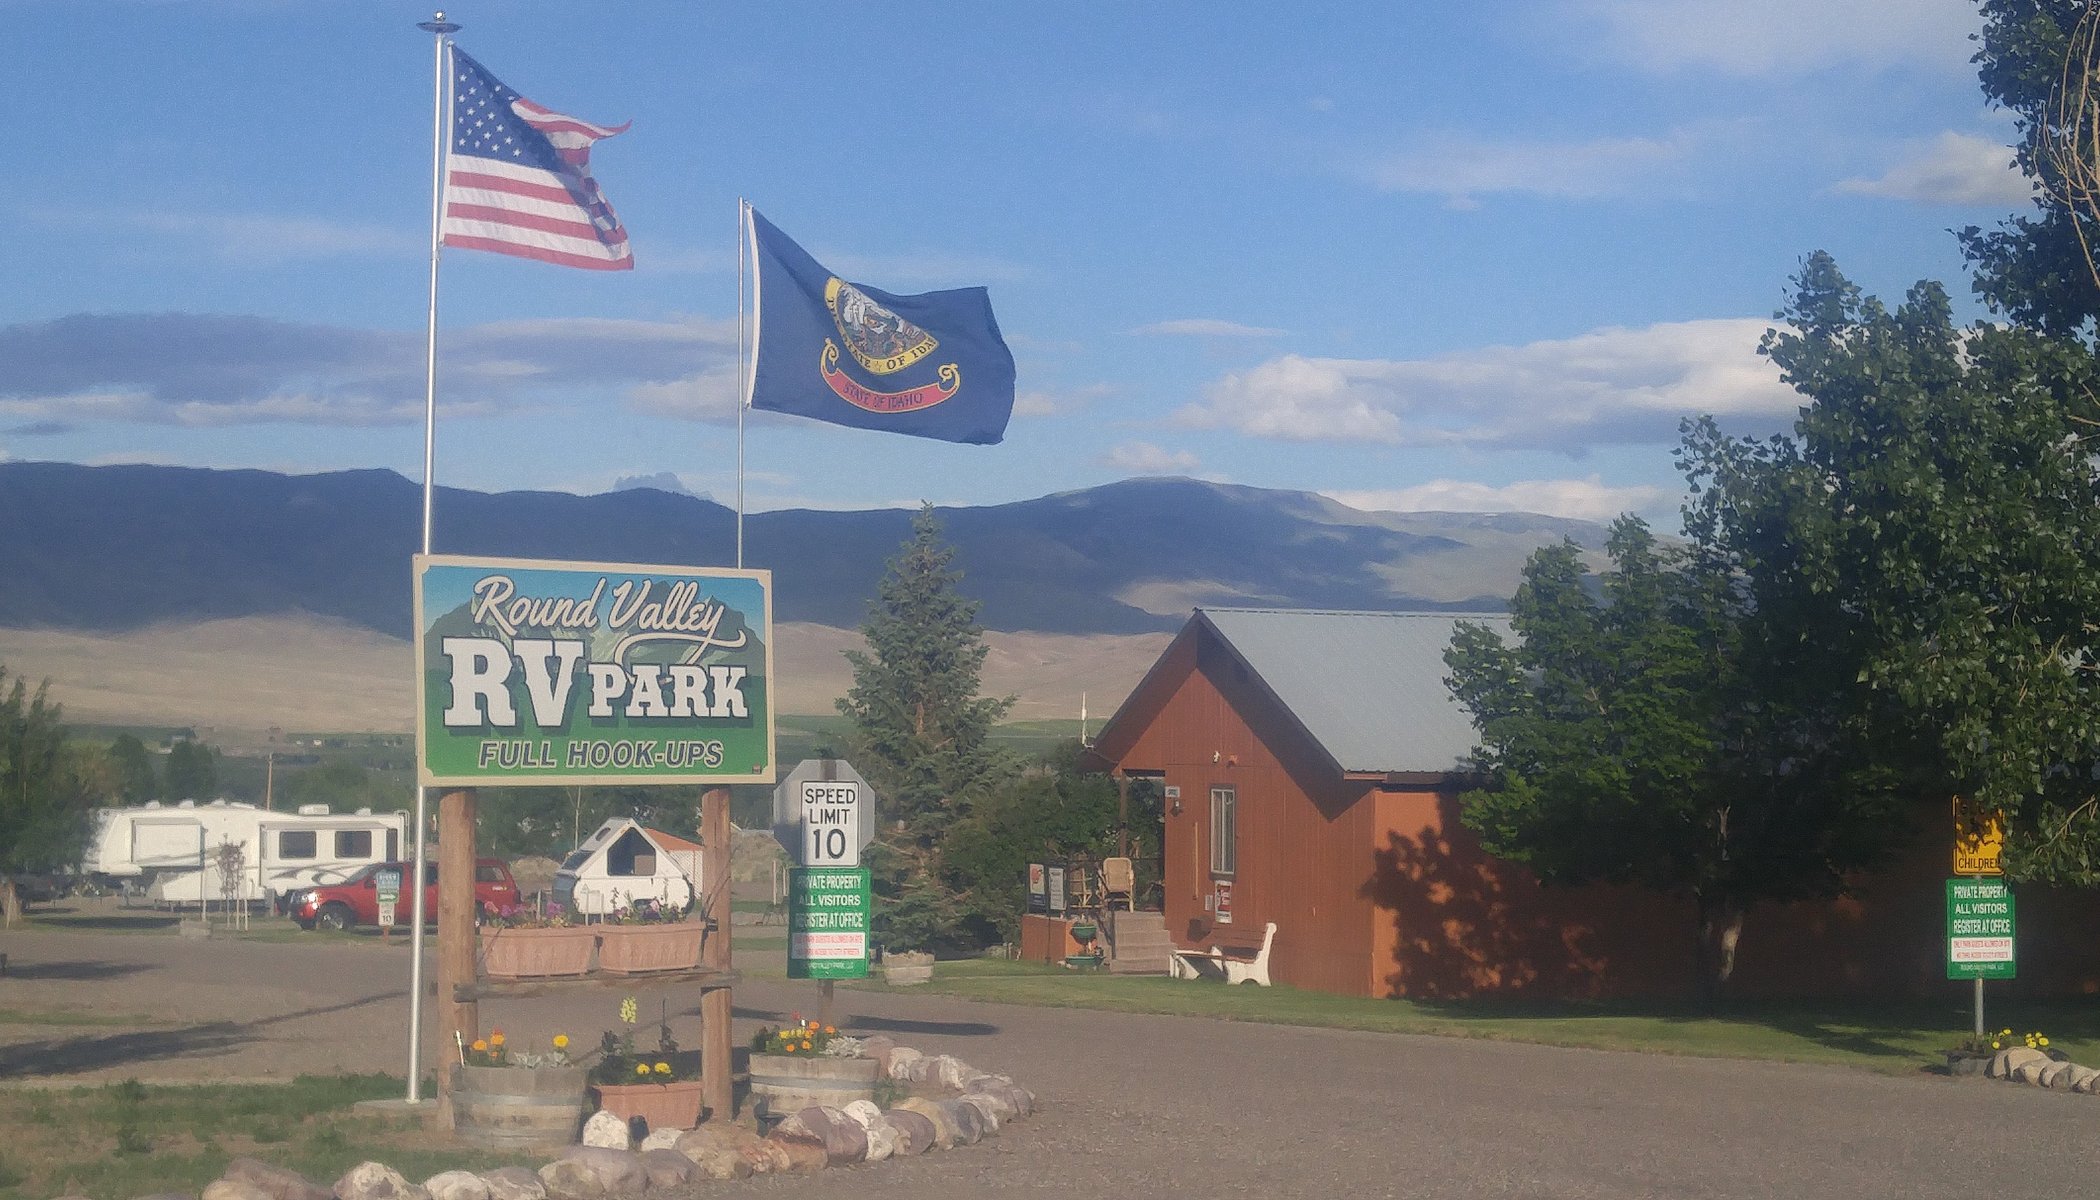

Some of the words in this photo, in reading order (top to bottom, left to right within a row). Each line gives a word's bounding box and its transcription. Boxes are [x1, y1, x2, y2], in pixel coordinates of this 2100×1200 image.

[886, 356, 906, 370] OF
[888, 393, 923, 409] IDAHO
[474, 575, 607, 636] Round
[608, 578, 744, 656] Valley
[442, 637, 585, 728] RV
[588, 663, 748, 718] PARK
[478, 740, 557, 769] FULL
[566, 740, 724, 769] HOOK-UPS
[804, 788, 856, 804] SPEED
[809, 808, 851, 825] LIMIT
[813, 828, 846, 860] 10
[826, 875, 862, 889] PROPERTY
[799, 894, 817, 906] ALL
[817, 894, 861, 906] VISITORS
[1953, 885, 1977, 899] PRIVATE
[1978, 885, 2008, 899] PROPERTY
[1955, 903, 1971, 914] ALL
[1972, 903, 2008, 914] VISITORS
[382, 915, 392, 923] 10
[829, 912, 838, 928] AT
[840, 912, 864, 928] OFFICE
[1953, 919, 1981, 934] REGISTER
[1981, 919, 1989, 934] AT
[1990, 919, 2010, 934] OFFICE
